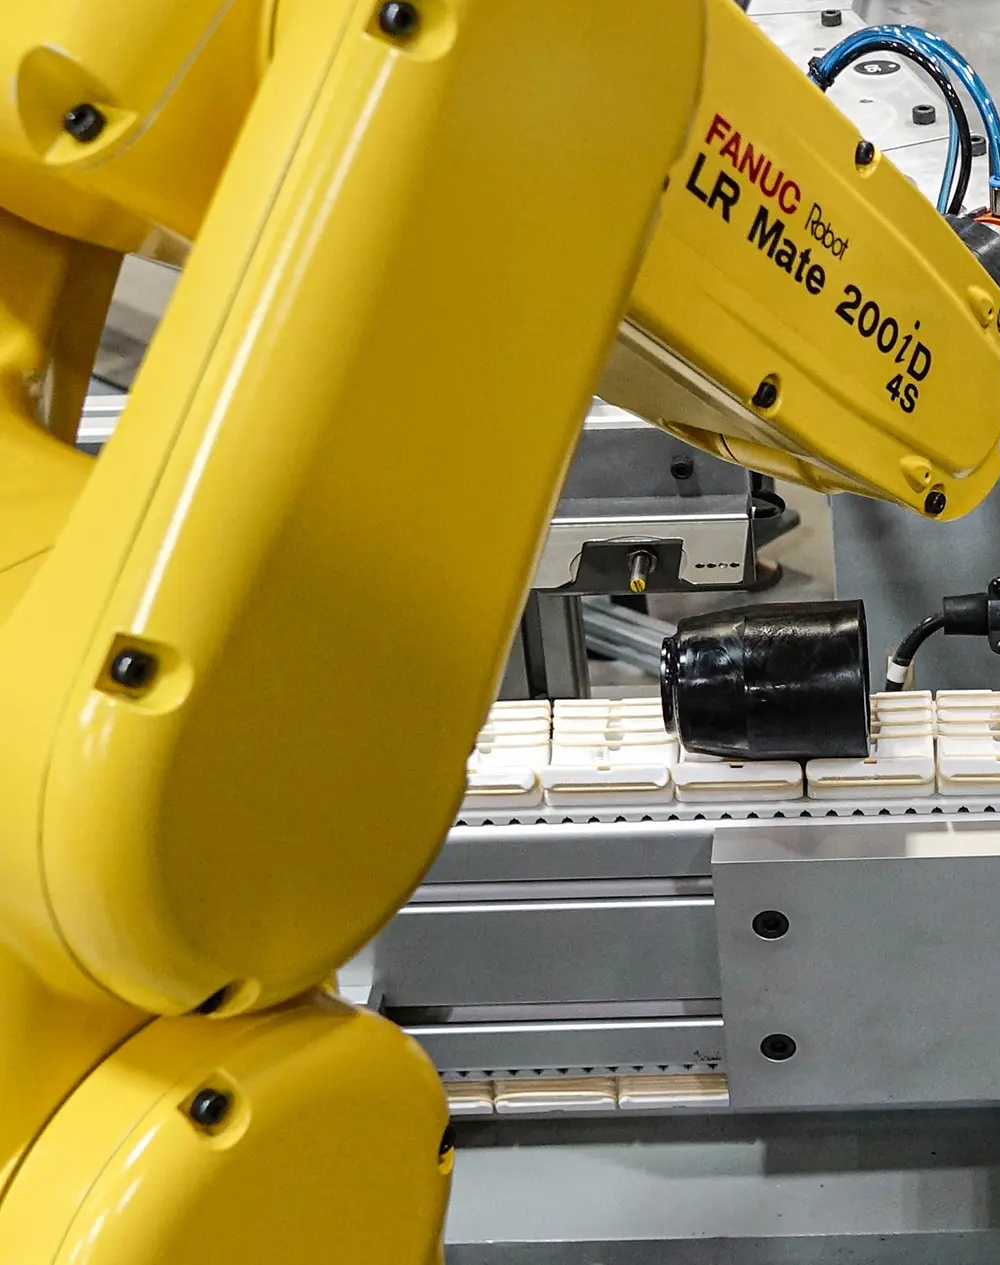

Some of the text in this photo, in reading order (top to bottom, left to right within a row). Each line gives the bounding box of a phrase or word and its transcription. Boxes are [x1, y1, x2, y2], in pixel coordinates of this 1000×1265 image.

[704, 113, 850, 260] FANUC Robot
[686, 154, 932, 382] LR Mate 200iD
[885, 373, 919, 414] 4S
